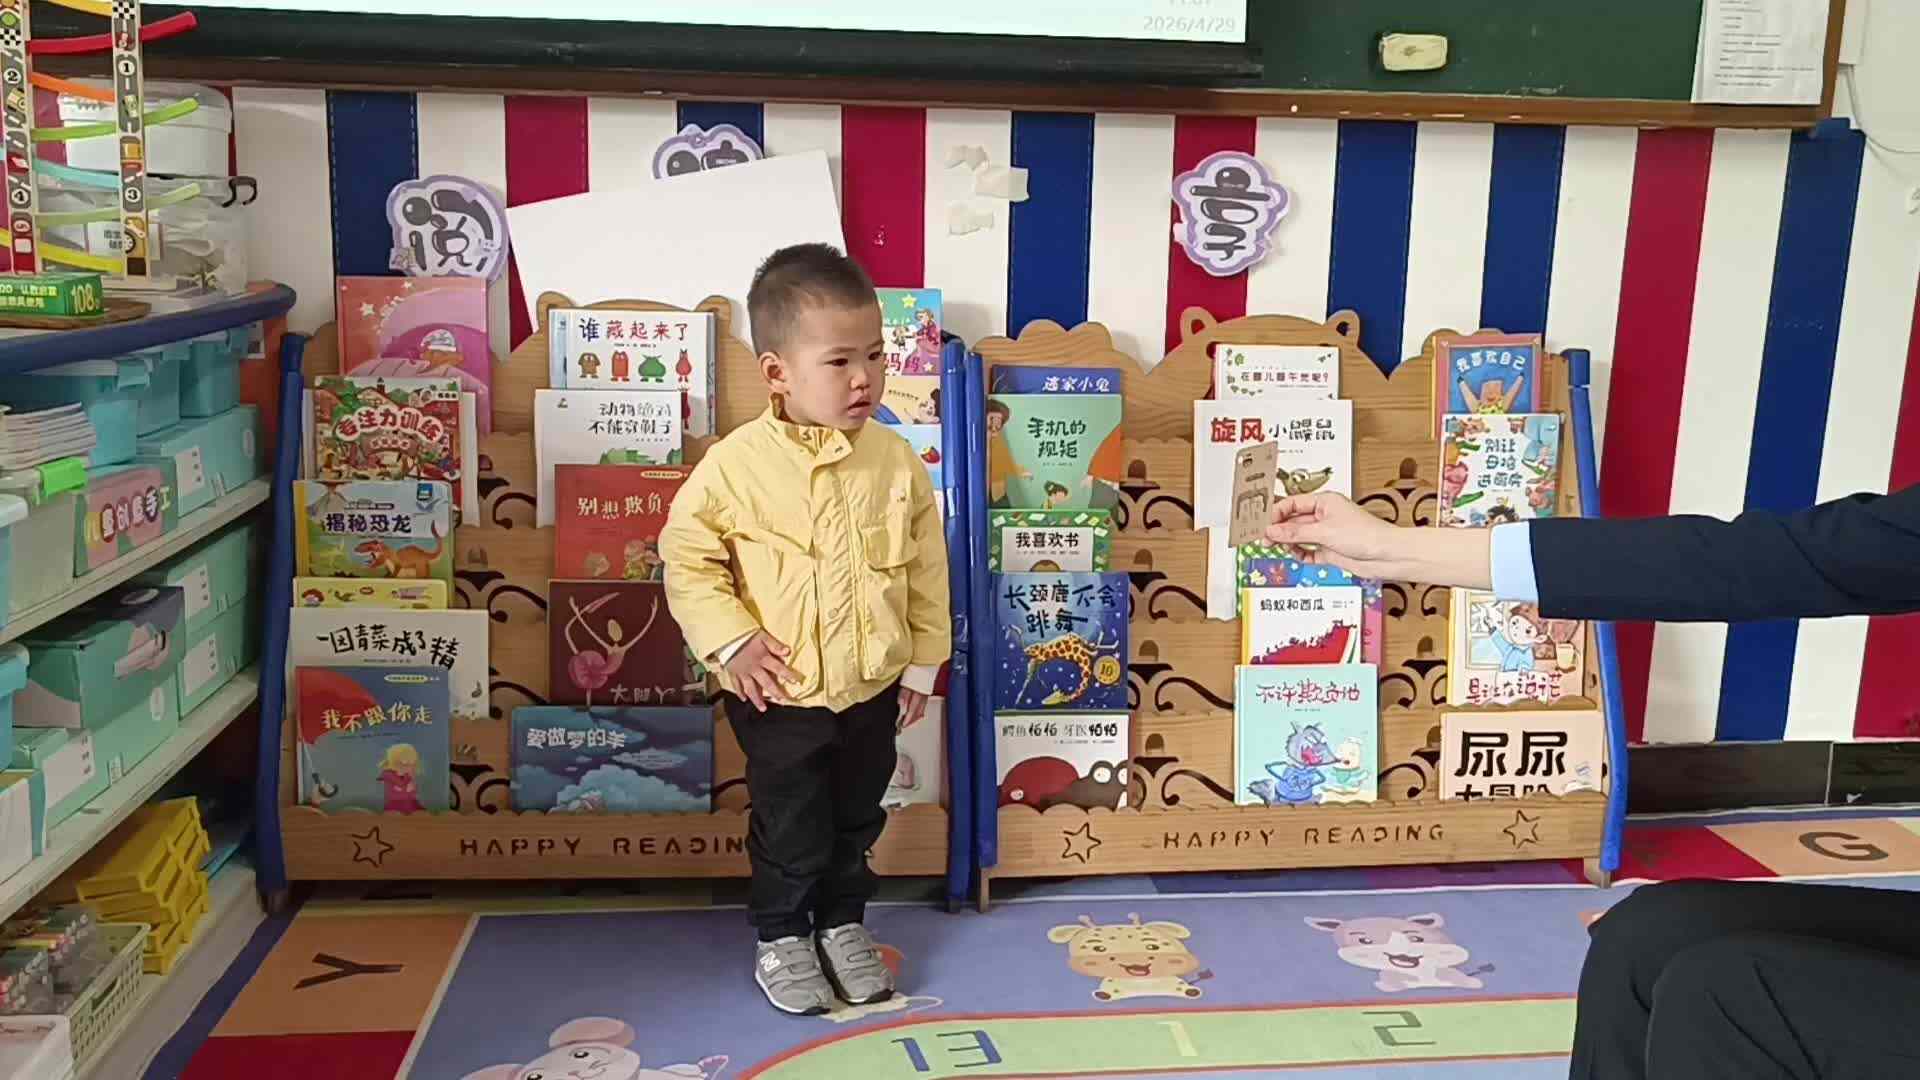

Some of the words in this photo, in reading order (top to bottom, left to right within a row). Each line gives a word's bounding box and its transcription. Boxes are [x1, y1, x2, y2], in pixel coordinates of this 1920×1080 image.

[1143, 15, 1235, 33] 2026/4/29
[6, 70, 19, 83] 2
[127, 186, 139, 201] 3
[402, 189, 494, 272] 说
[72, 283, 96, 313] 108
[578, 317, 689, 343] 谁藏起来了
[1028, 416, 1087, 438] 手机的
[1210, 416, 1336, 443] 旋风小鼹鼠
[1037, 439, 1078, 459] 规矩
[577, 491, 673, 520] 别想欺负
[326, 512, 412, 534] 揭秘恐龙
[1015, 531, 1080, 549] 我喜欢书
[1003, 579, 1117, 612] 长颈鹿不会
[1259, 598, 1326, 612] 蚂蚁和西瓜
[1025, 607, 1089, 638] 跳舞
[1255, 677, 1361, 707] 不许欺负他
[320, 702, 433, 733] 我不跟你走
[1454, 730, 1568, 778] 尿尿
[460, 836, 582, 857] HAPPY
[612, 835, 744, 855] READIN
[1163, 828, 1276, 849] HAPPY
[1304, 823, 1447, 845] READING
[1798, 831, 1890, 862] G
[293, 951, 405, 991] Y
[1156, 1020, 1199, 1058] 1
[1361, 1010, 1438, 1047] 2
[891, 1029, 1003, 1073] 13
